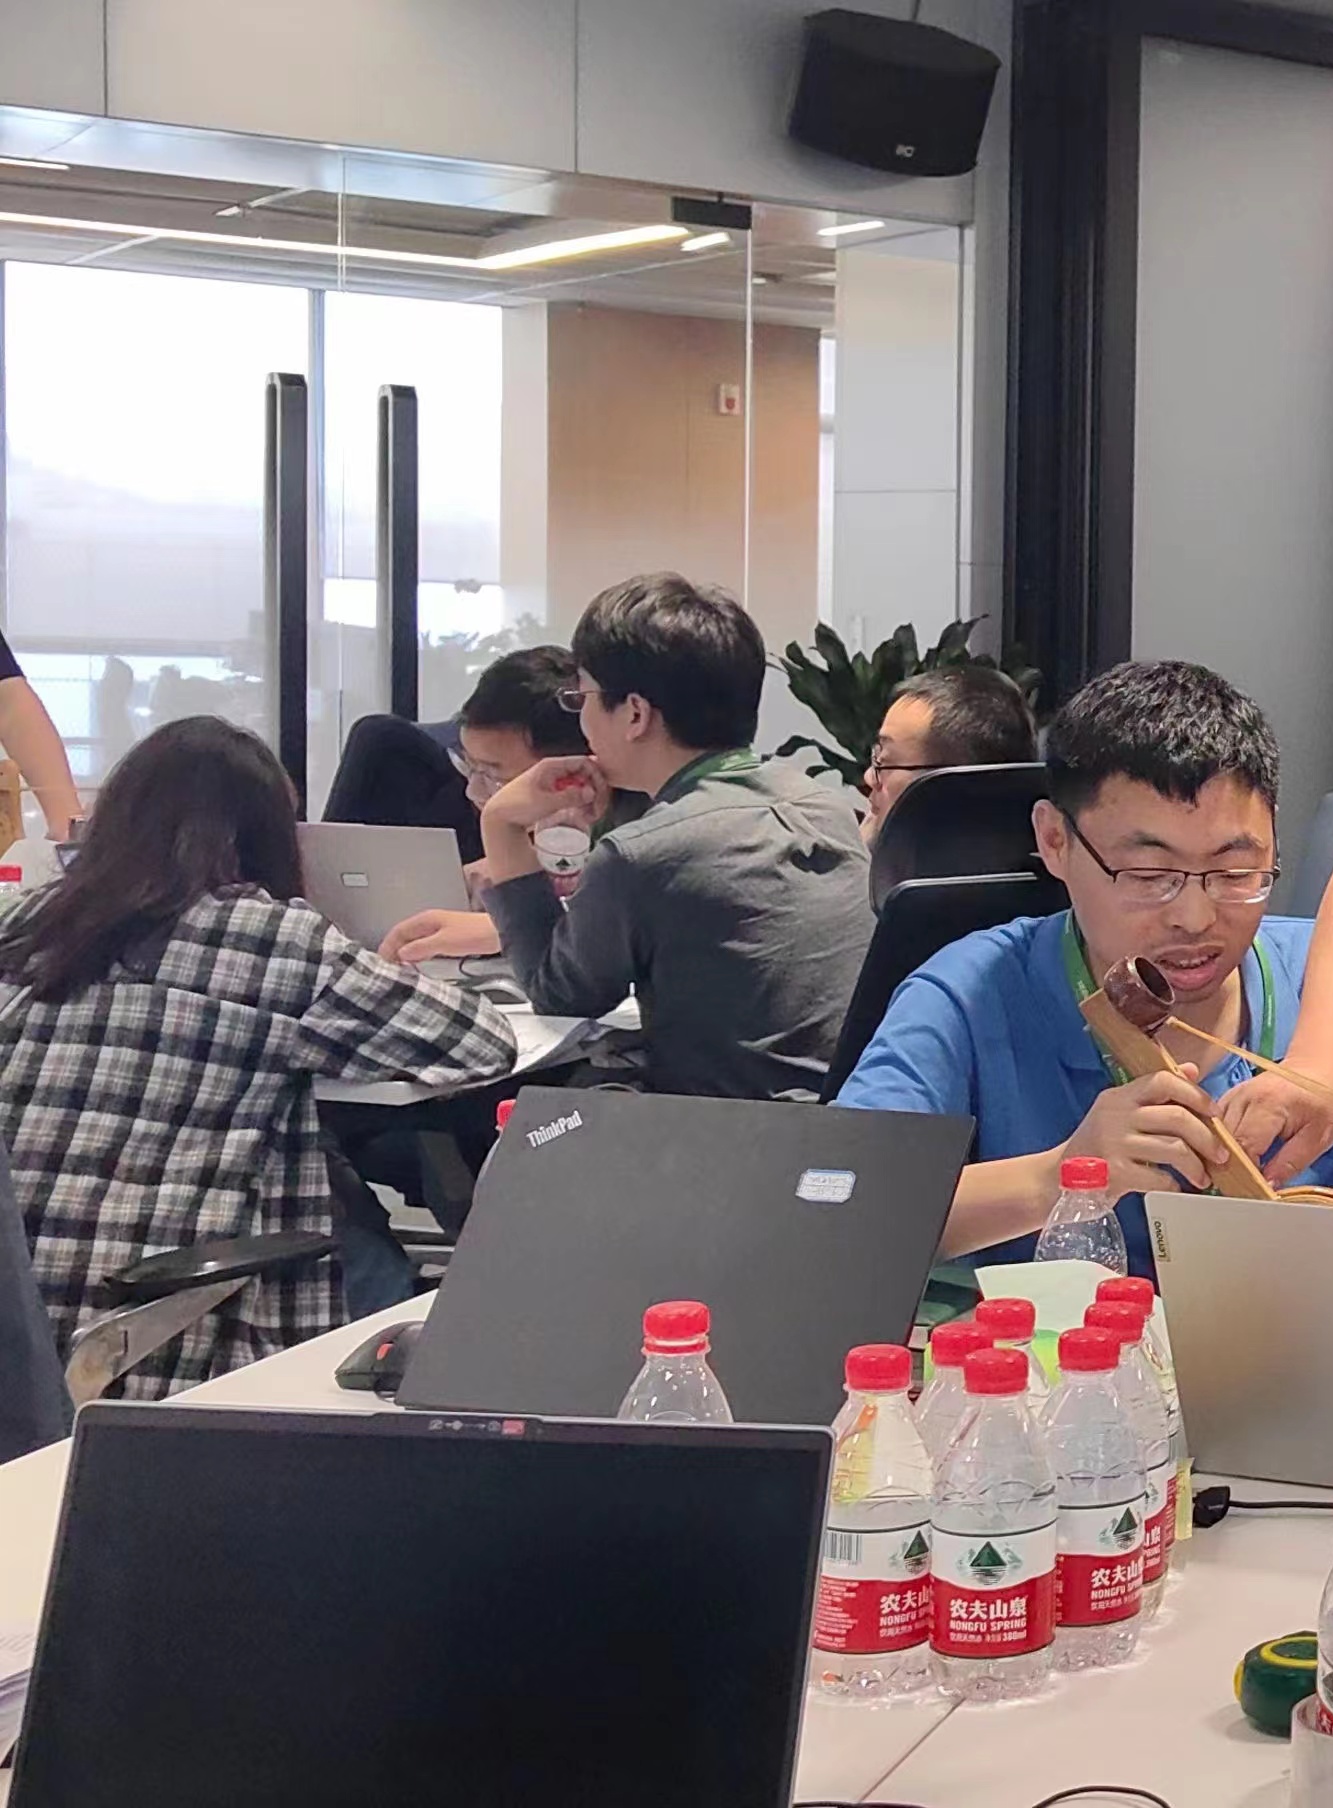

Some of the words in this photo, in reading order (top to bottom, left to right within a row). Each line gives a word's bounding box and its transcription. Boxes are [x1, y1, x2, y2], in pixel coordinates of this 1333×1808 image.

[526, 1110, 583, 1147] ThinkPad
[1154, 1220, 1167, 1258] Lenovo
[1091, 1556, 1144, 1588] 农夫山
[879, 1613, 916, 1627] NONGFU
[949, 1595, 1028, 1620] 农夫山泉
[949, 1619, 987, 1632] NONGFU
[990, 1617, 1027, 1632] SPRING
